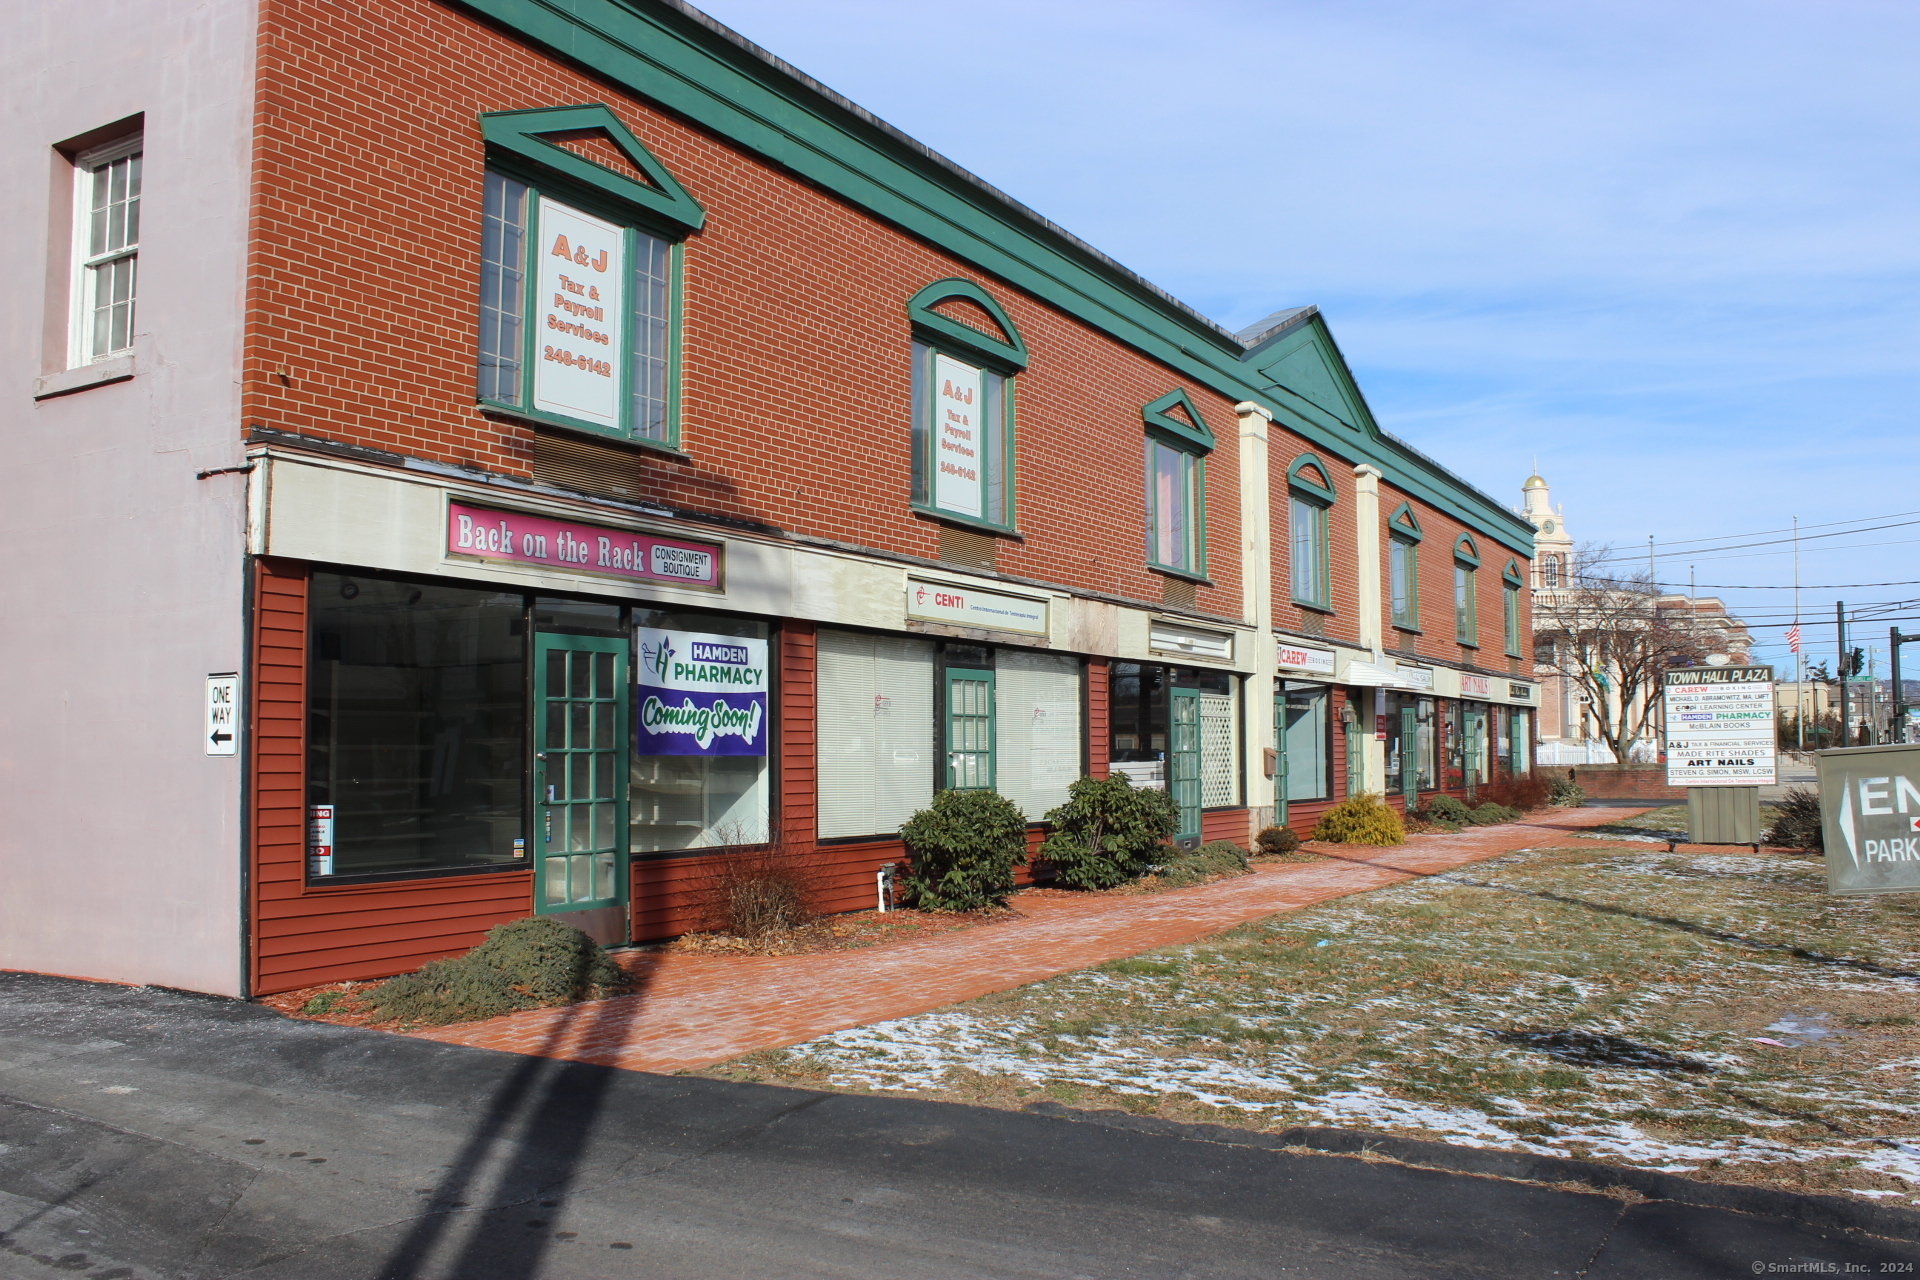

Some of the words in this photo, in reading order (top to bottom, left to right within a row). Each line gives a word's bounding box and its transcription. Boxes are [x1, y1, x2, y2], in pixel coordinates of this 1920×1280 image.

[552, 234, 608, 272] A&J
[559, 274, 584, 296] Tax
[588, 286, 600, 302] &
[554, 292, 604, 322] Payroll
[547, 314, 609, 346] Services
[544, 345, 610, 377] 248-6142
[942, 380, 973, 405] A&J
[946, 408, 961, 424] Tax
[962, 414, 969, 426] &
[944, 422, 972, 441] Payroll
[942, 438, 974, 458] Services
[940, 460, 976, 481] 248-6142
[458, 514, 514, 554] Back
[522, 532, 548, 558] on
[556, 530, 588, 564] the
[598, 536, 645, 572] Rack
[655, 547, 708, 566] CONSIGNMENT
[663, 562, 700, 578] BOUTIQUE
[934, 592, 964, 609] CENTI
[693, 644, 746, 662] HAMDEN
[1282, 649, 1307, 666] CAREW
[674, 662, 762, 685] PHARMACY
[1668, 672, 1700, 684] TOWN
[1702, 670, 1729, 683] HALL
[1732, 669, 1768, 682] PLAZA
[1461, 675, 1471, 692] ART
[1473, 677, 1488, 694] NAILS
[212, 686, 230, 704] ONE
[212, 707, 231, 724] WAY
[644, 698, 710, 742] Coming
[710, 700, 756, 738] Soon!
